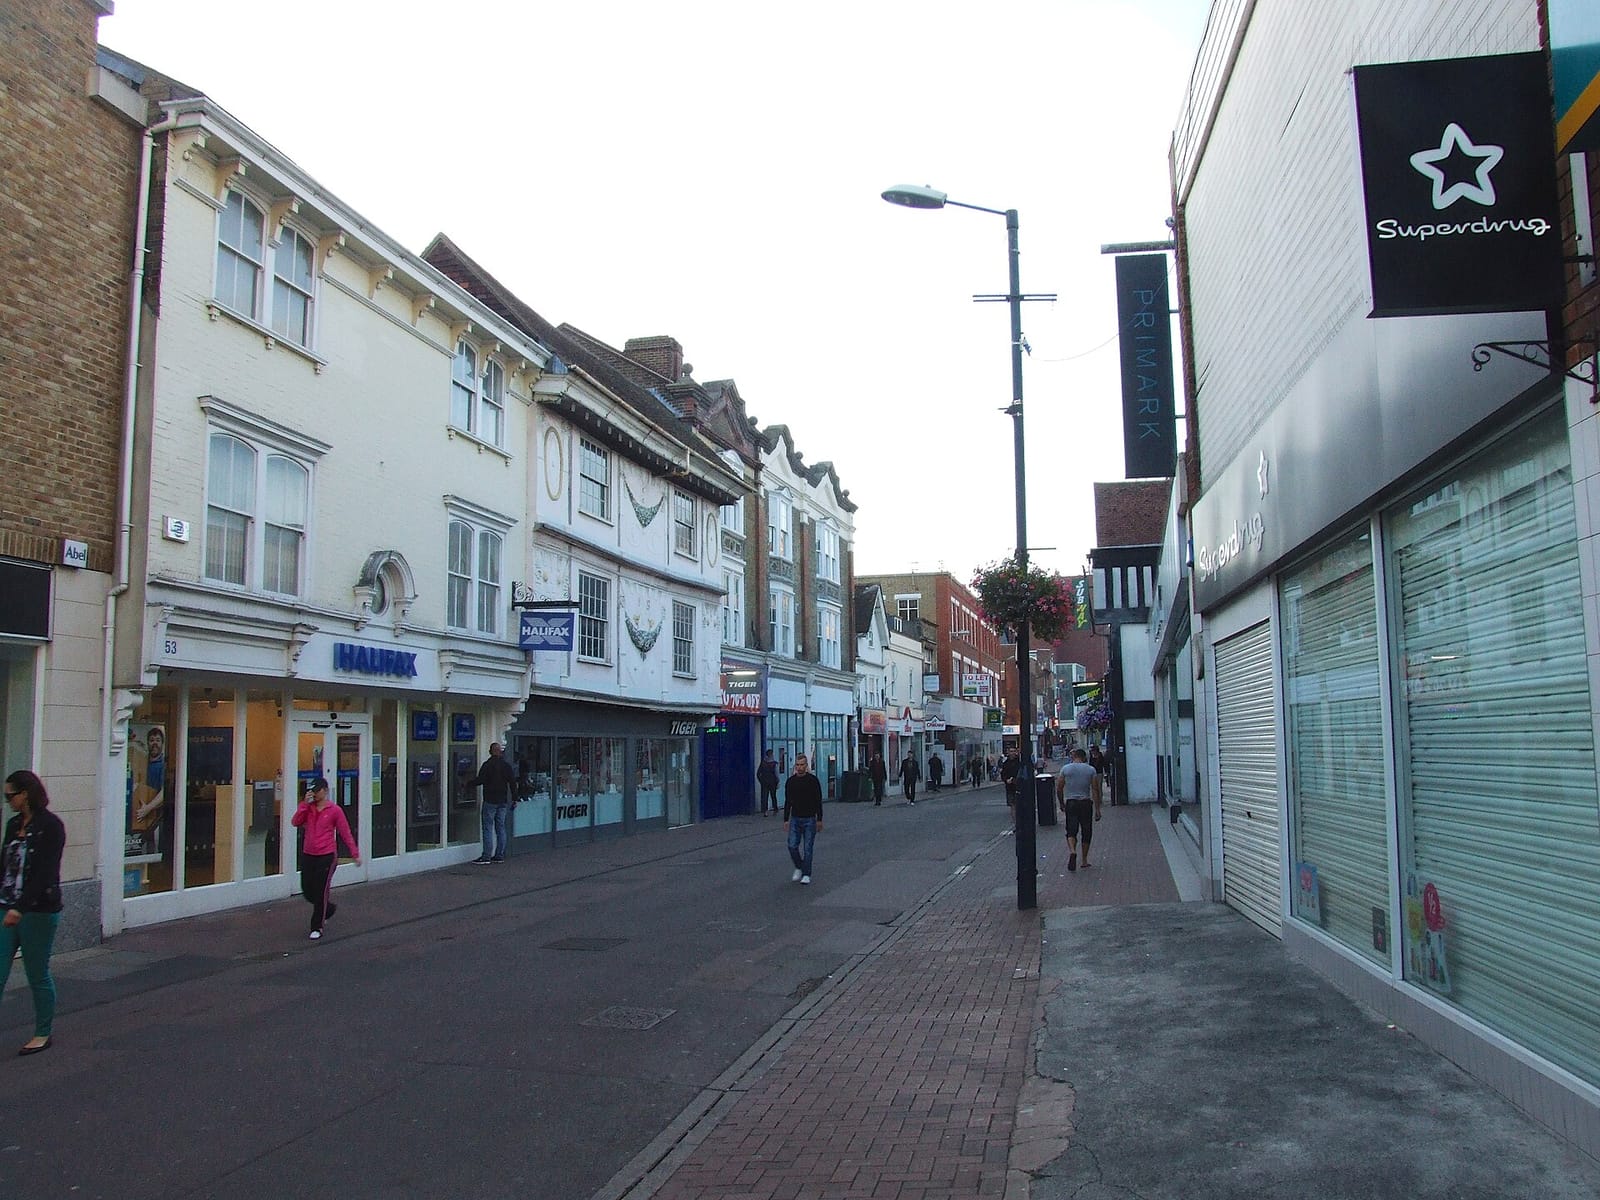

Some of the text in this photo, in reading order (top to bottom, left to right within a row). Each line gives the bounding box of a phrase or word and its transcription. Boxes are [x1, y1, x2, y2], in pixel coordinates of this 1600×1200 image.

[1376, 216, 1551, 241] Superdrug
[1132, 289, 1161, 440] PRIMARK
[65, 544, 88, 563] Abel
[1199, 511, 1265, 583] Superdrug
[1075, 580, 1088, 629] SUBWAY
[521, 625, 569, 638] HALIFAX
[164, 640, 178, 655] 53
[333, 643, 418, 677] HALIFAX
[745, 693, 761, 709] OFF
[670, 720, 697, 736] TIGER
[556, 803, 588, 819] TIGER
